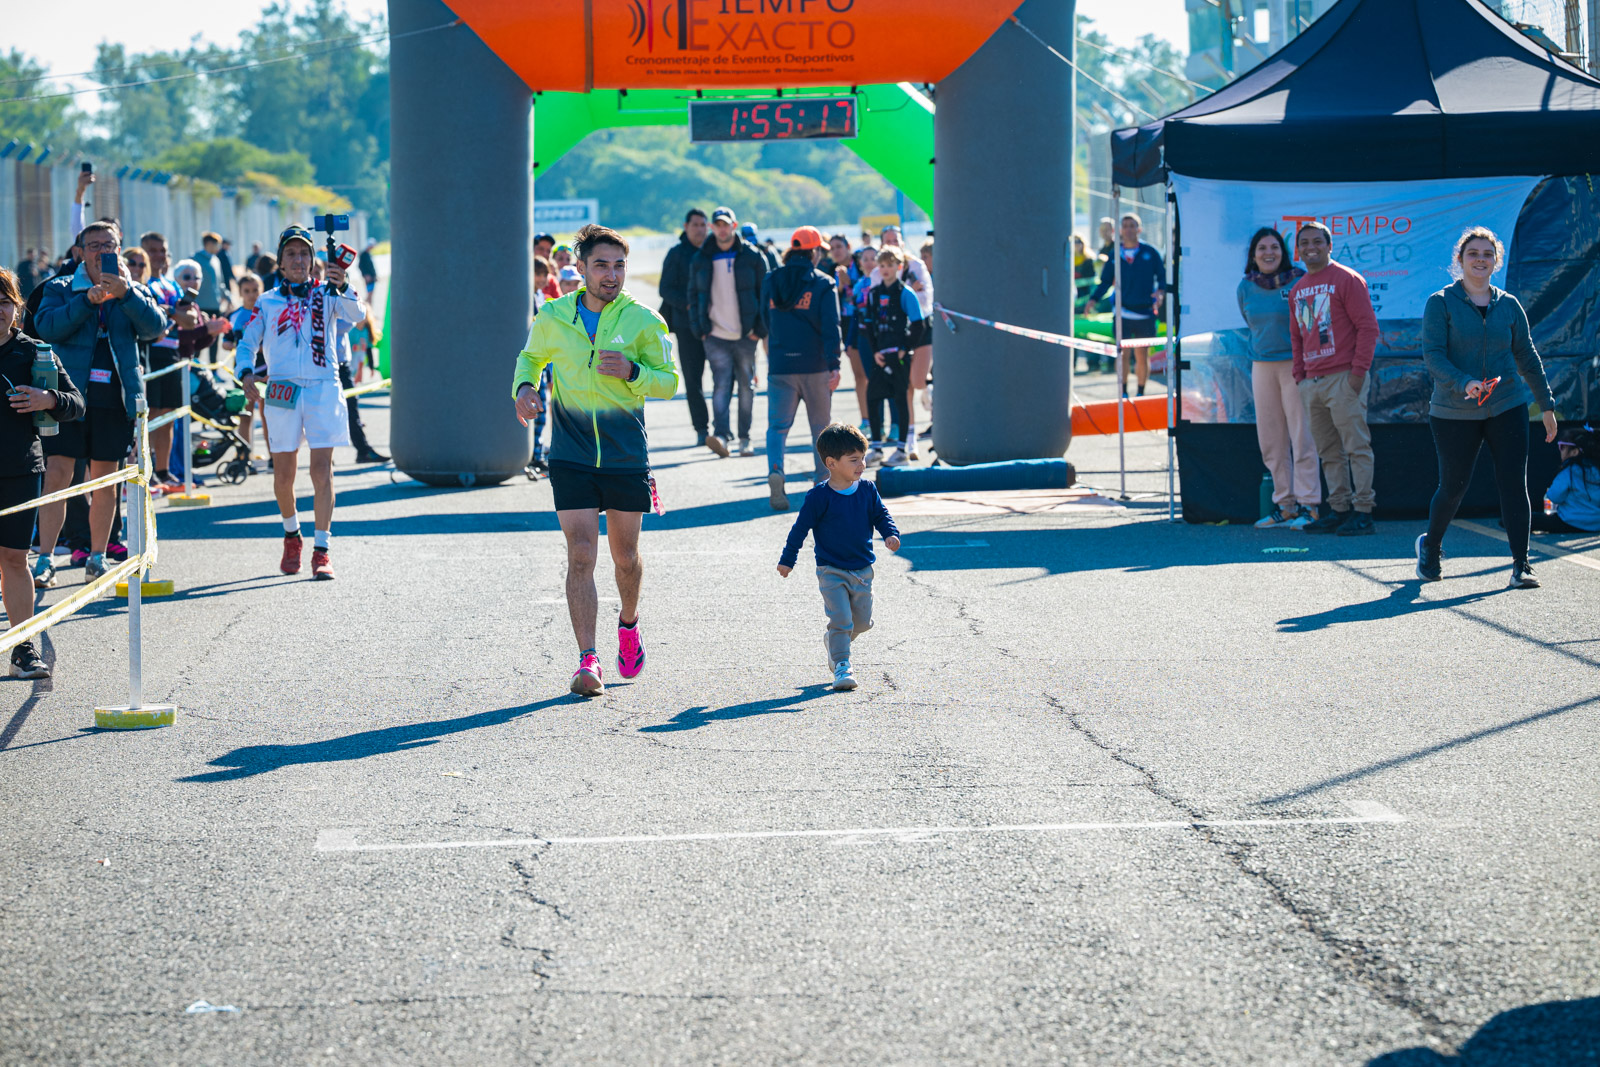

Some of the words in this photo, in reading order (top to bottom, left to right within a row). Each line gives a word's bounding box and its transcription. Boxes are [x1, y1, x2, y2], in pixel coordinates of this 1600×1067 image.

[626, 55, 708, 66] Cronometraje
[713, 54, 728, 65] de
[732, 54, 781, 64] Eventos
[785, 53, 854, 65] Deportivos
[731, 101, 852, 138] 1:55:17
[1362, 269, 1409, 278] Deportivos
[1294, 284, 1336, 300] ANHATTAN
[270, 383, 293, 401] 370
